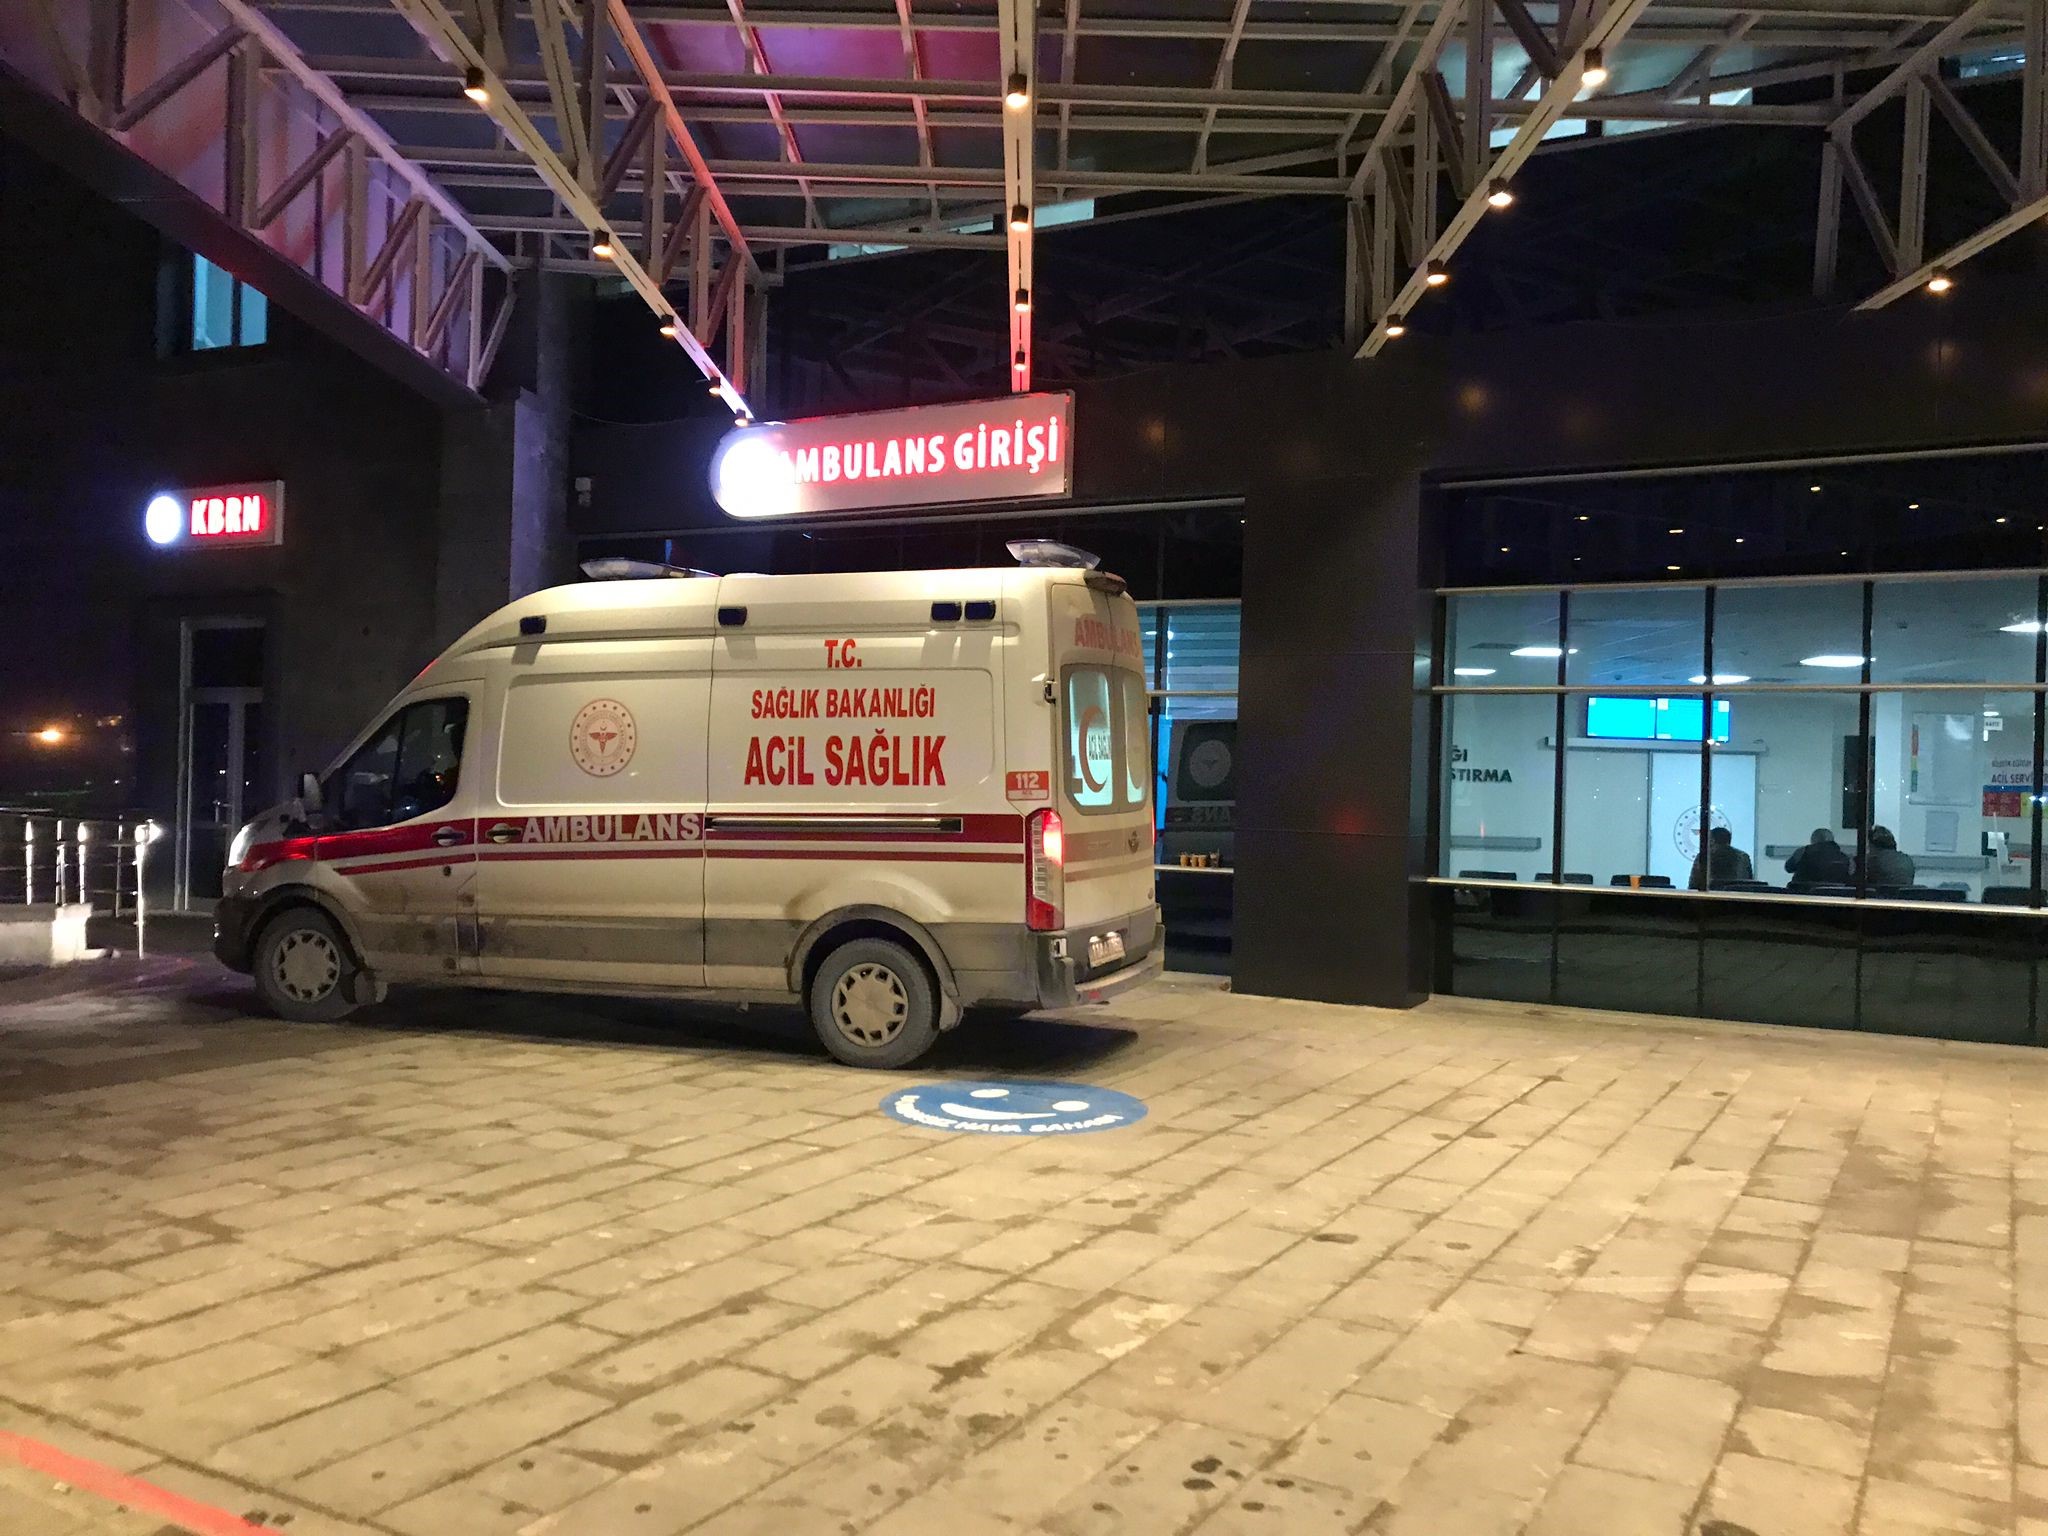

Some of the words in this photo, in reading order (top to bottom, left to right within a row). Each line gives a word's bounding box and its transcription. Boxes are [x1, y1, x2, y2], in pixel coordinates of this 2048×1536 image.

[953, 416, 1058, 474] GİRİŞİ
[191, 495, 260, 535] KBRN
[824, 638, 863, 668] T.C.
[751, 686, 819, 719] SAĞLIK
[826, 684, 935, 718] BAKANLIĞI
[824, 728, 947, 786] SAĞLIK
[1015, 772, 1040, 789] 112
[522, 813, 700, 843] AMBULANS
